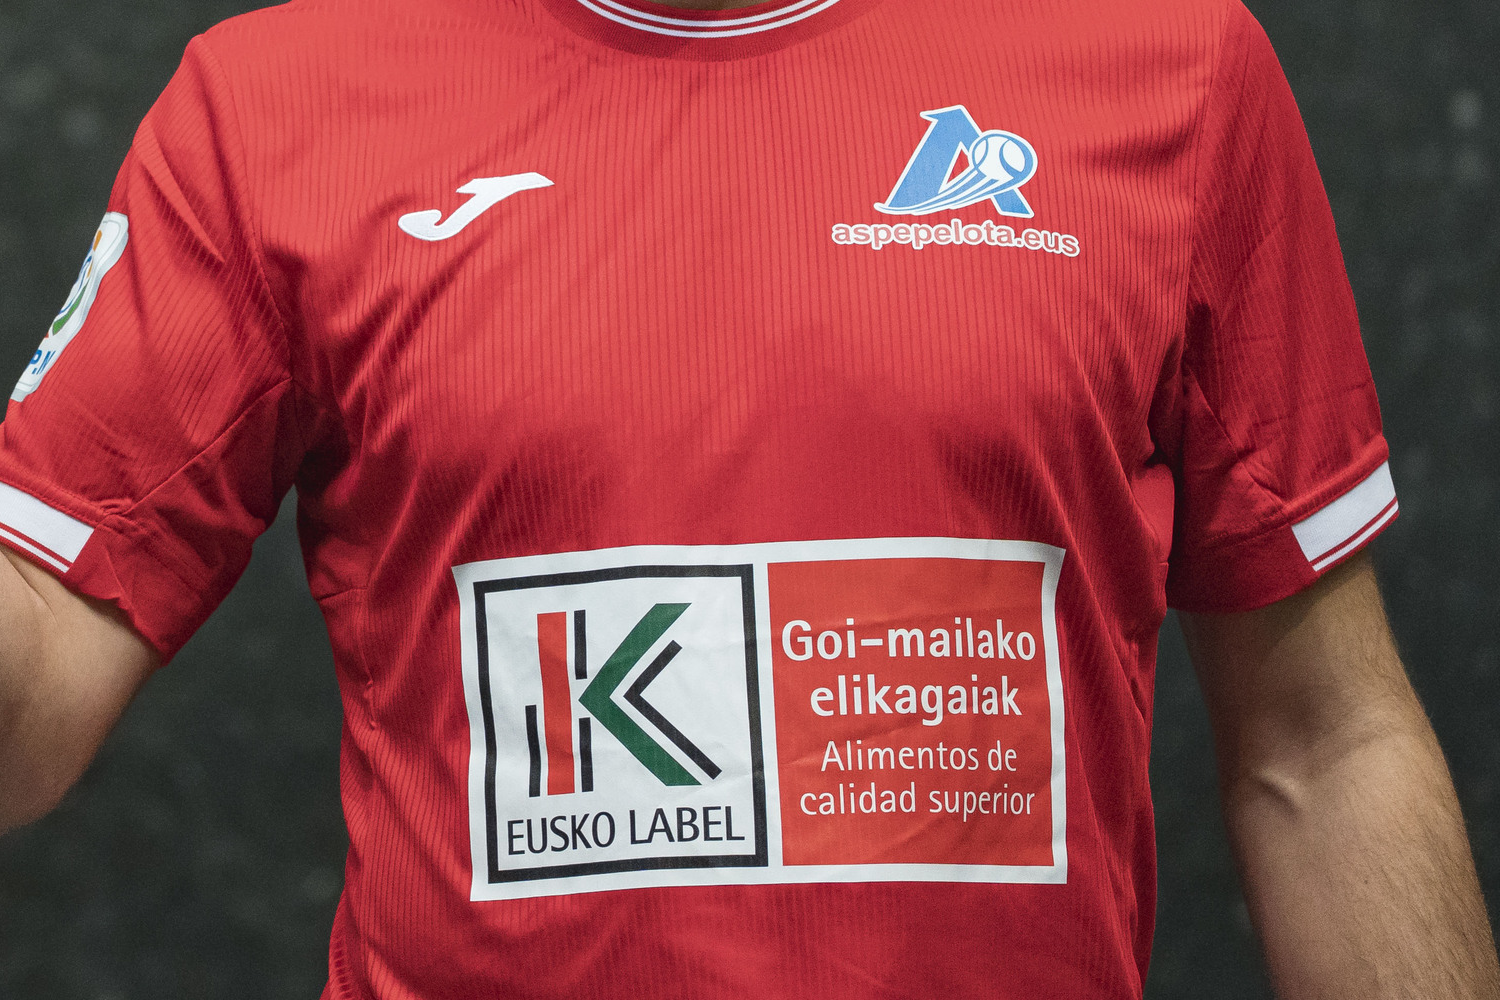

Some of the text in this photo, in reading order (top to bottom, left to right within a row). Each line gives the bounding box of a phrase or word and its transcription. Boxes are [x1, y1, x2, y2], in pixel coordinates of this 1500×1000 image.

[831, 218, 1080, 257] aspepelota.eus
[781, 616, 1037, 662] Goi-mailako
[810, 673, 1023, 726] elikagaiak
[820, 739, 1018, 772] Alimentos de
[800, 781, 1036, 823] calidad superior
[507, 805, 746, 856] EUSKO LABEL
